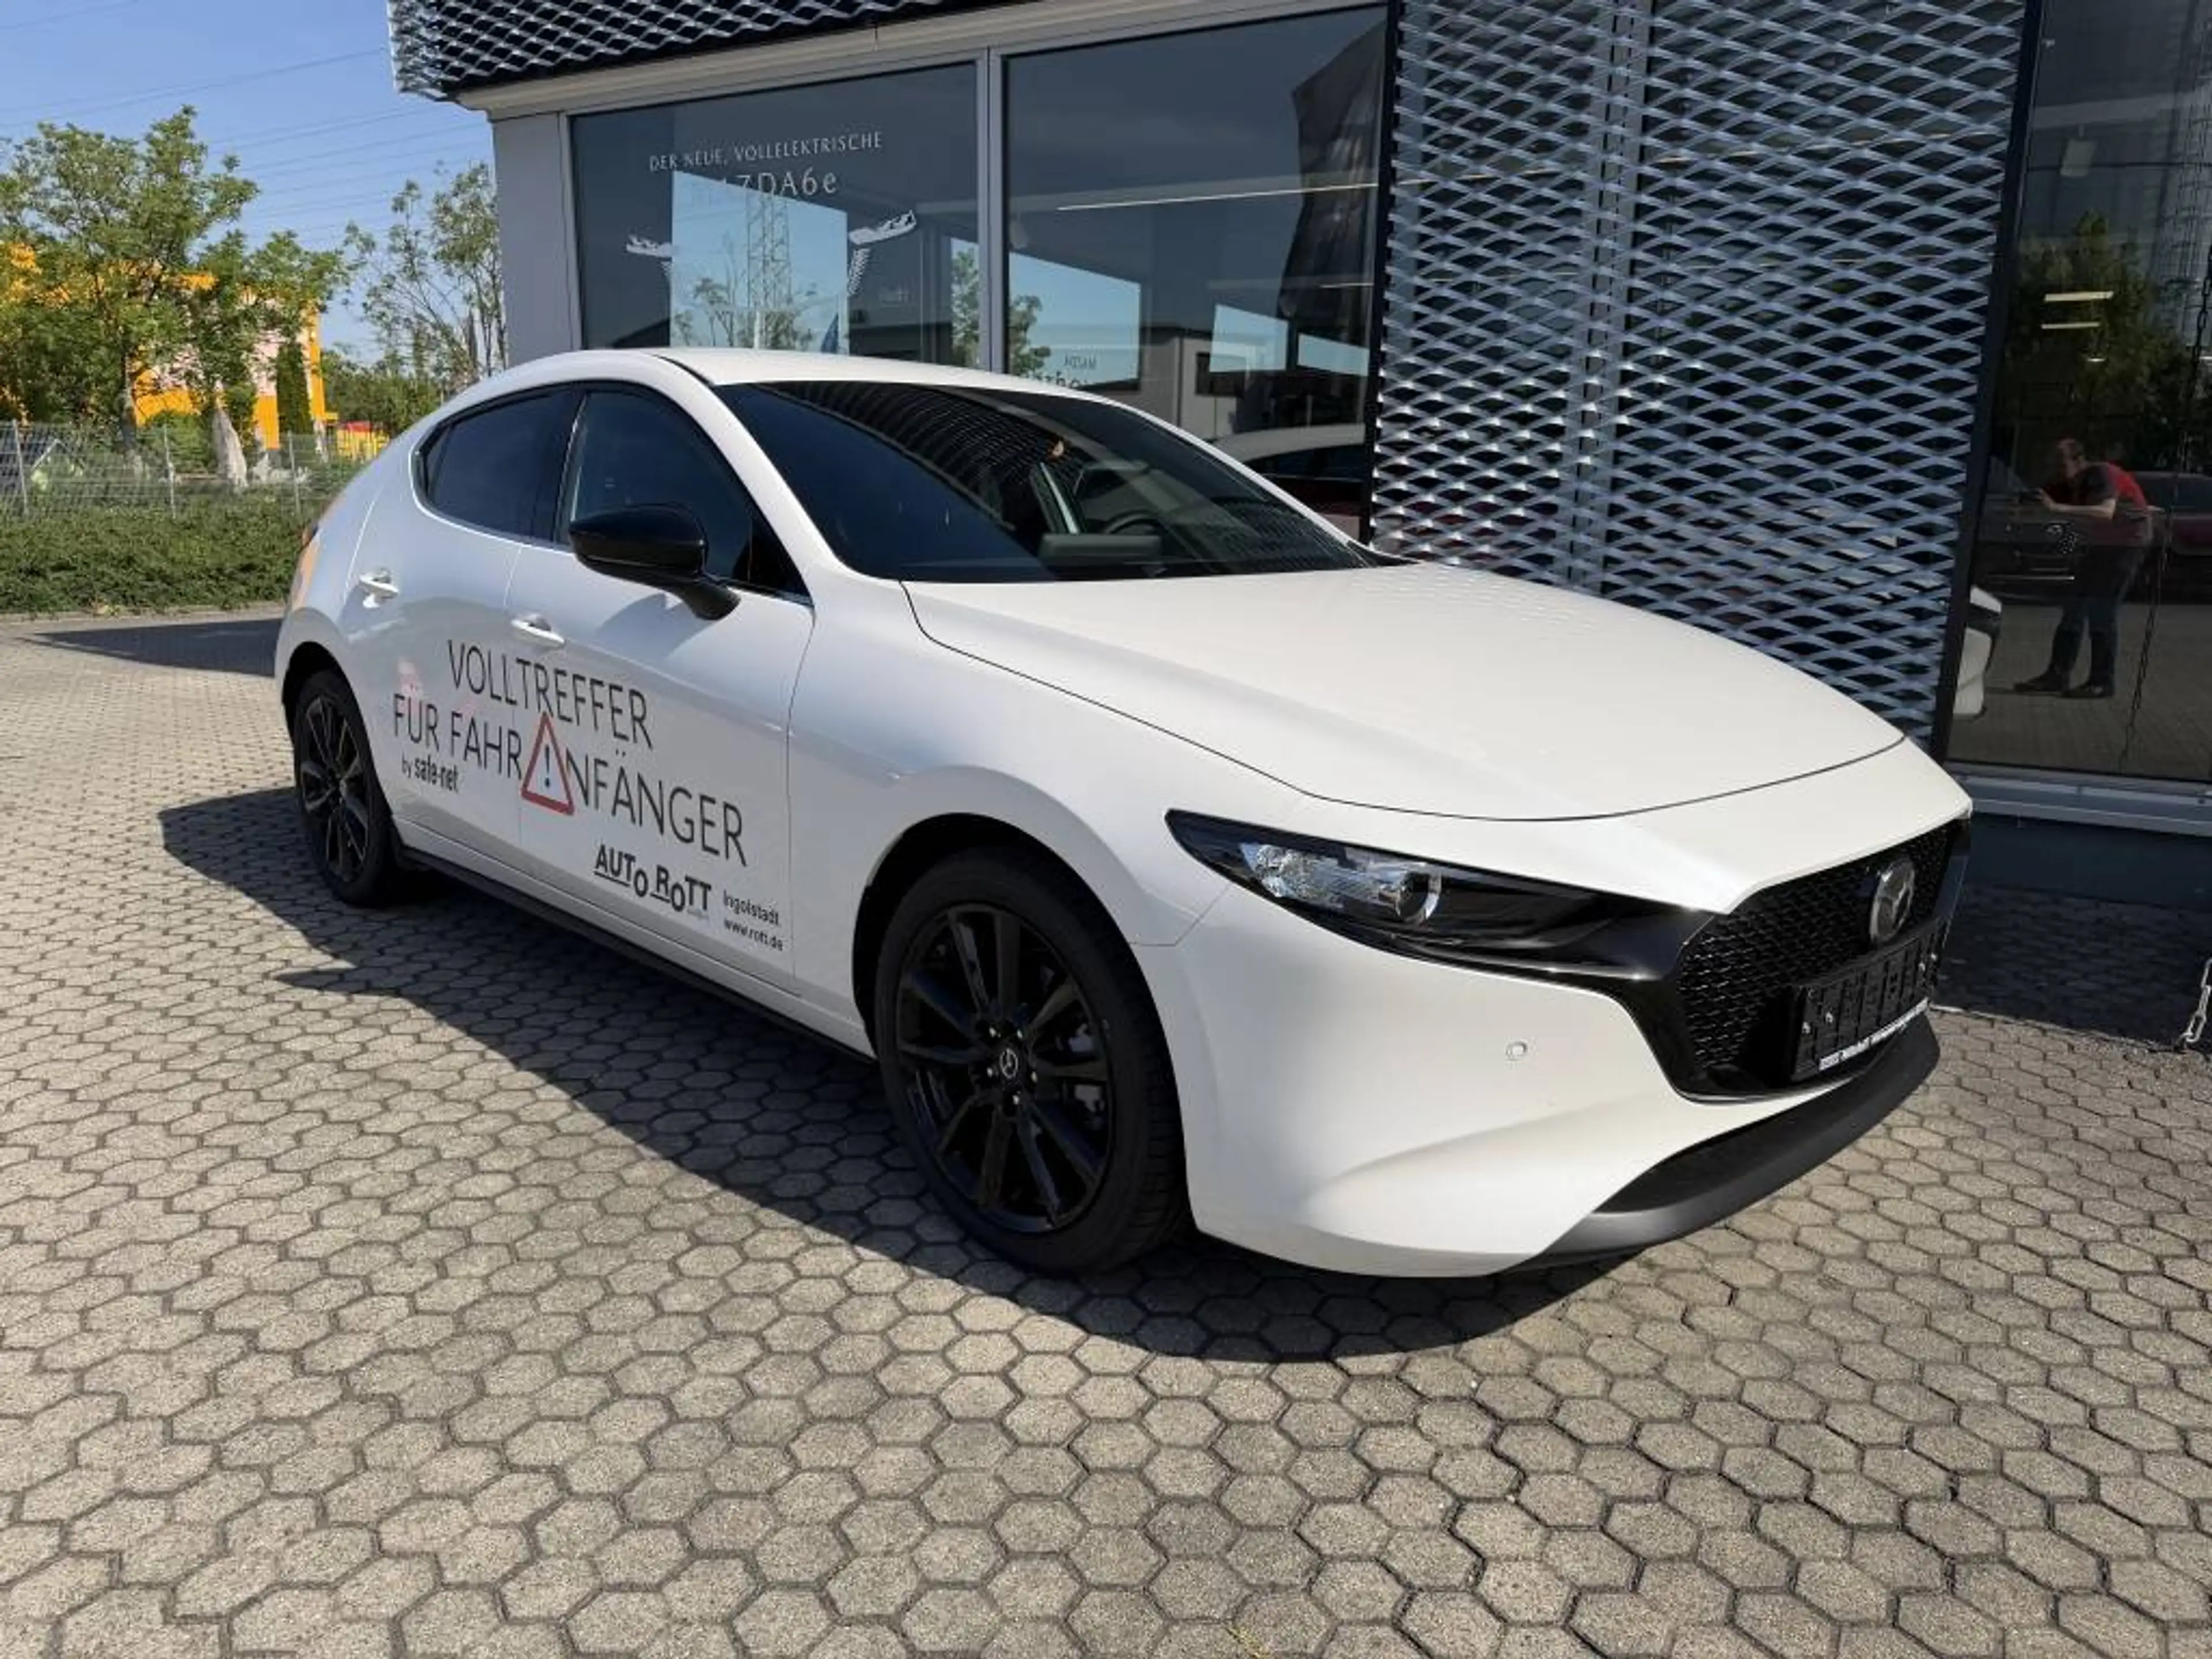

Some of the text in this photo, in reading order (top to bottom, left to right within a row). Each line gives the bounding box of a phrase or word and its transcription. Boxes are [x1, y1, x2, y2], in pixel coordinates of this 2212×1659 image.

[649, 154, 678, 172] DER
[733, 131, 882, 162] VOLLELEKTRISCHE
[448, 640, 653, 750] VOLLTREFFER
[402, 750, 459, 793] by safe-net
[724, 889, 779, 926] Ingolstadt
[724, 918, 783, 951] www.rott.de
